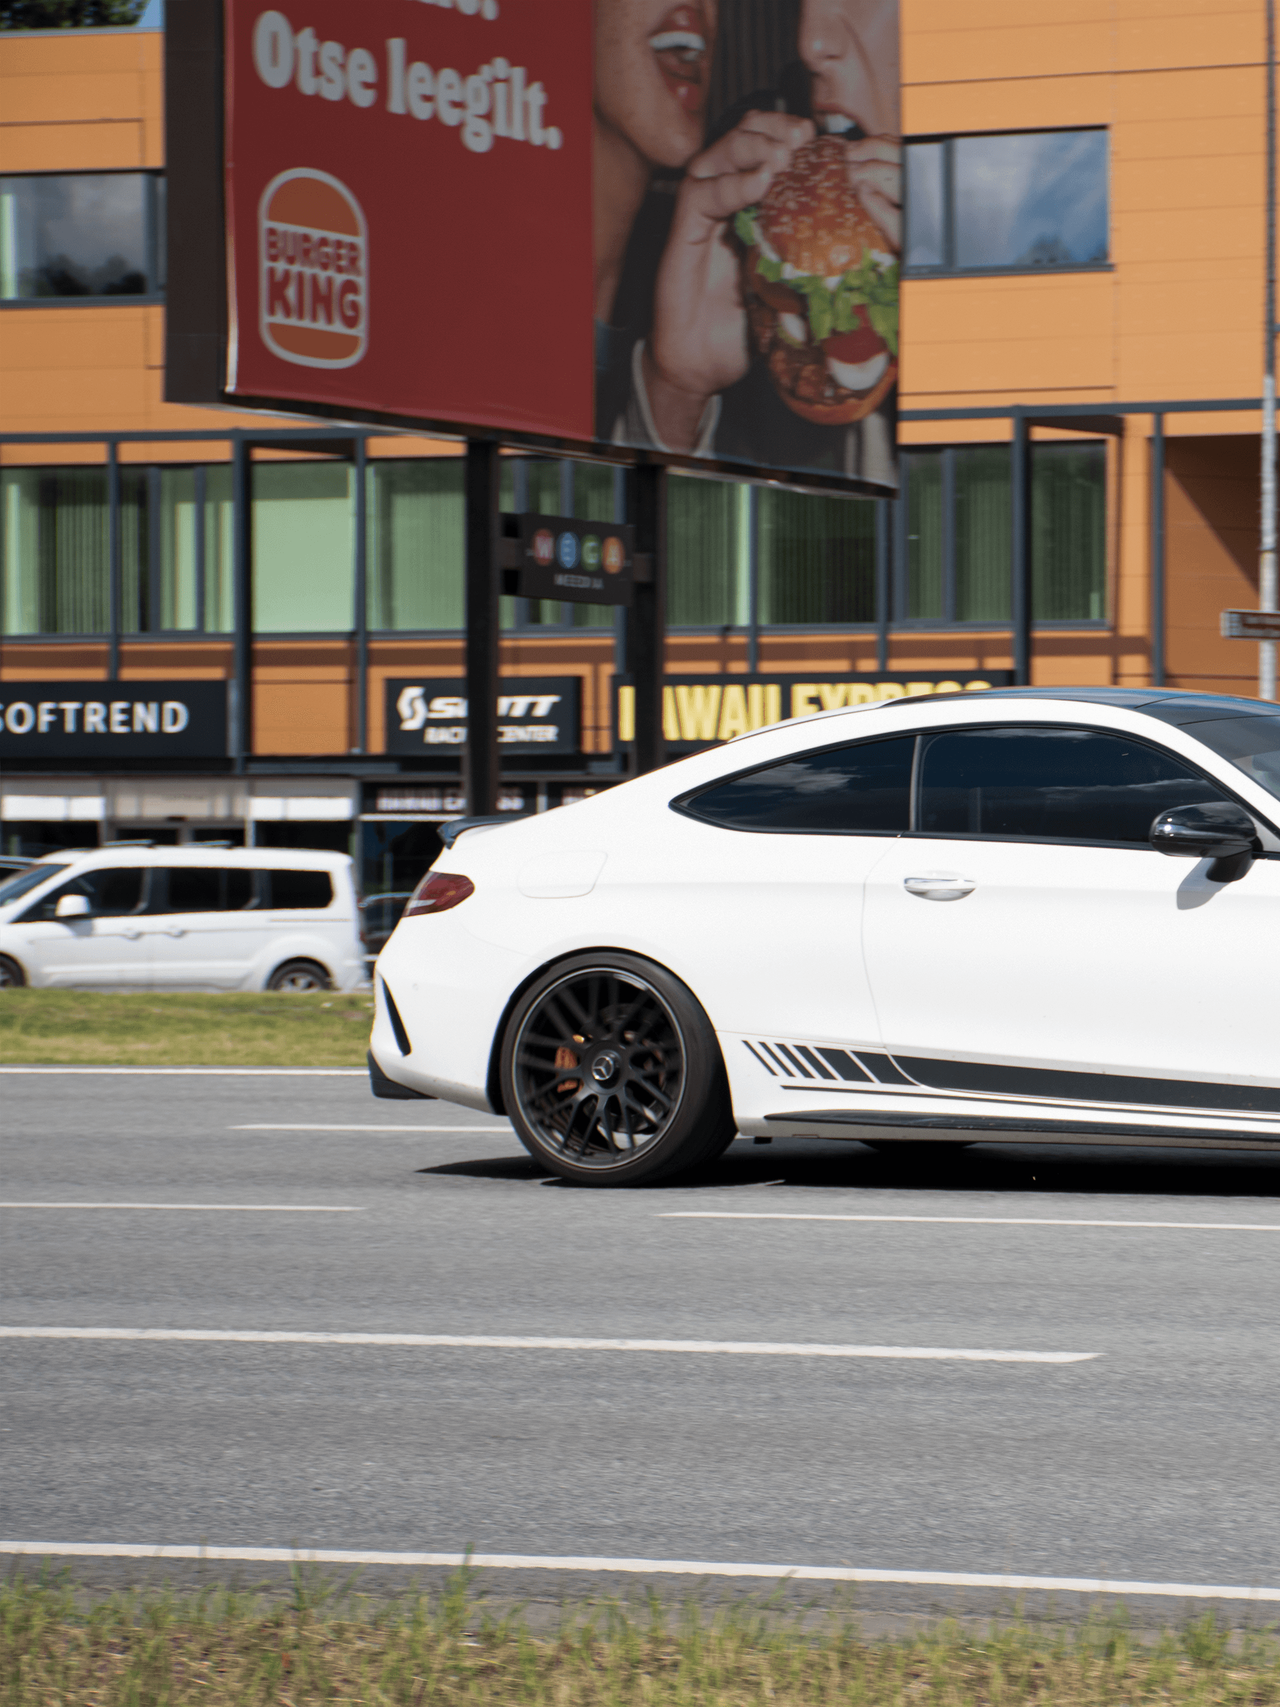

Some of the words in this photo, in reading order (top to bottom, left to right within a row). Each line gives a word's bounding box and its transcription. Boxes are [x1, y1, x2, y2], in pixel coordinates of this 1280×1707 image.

[253, 9, 377, 108] Otse
[386, 37, 563, 153] leegilt.
[265, 227, 362, 278] BURGER
[266, 266, 361, 330] KING
[0, 701, 190, 734] OFTREND
[427, 695, 561, 719] STT
